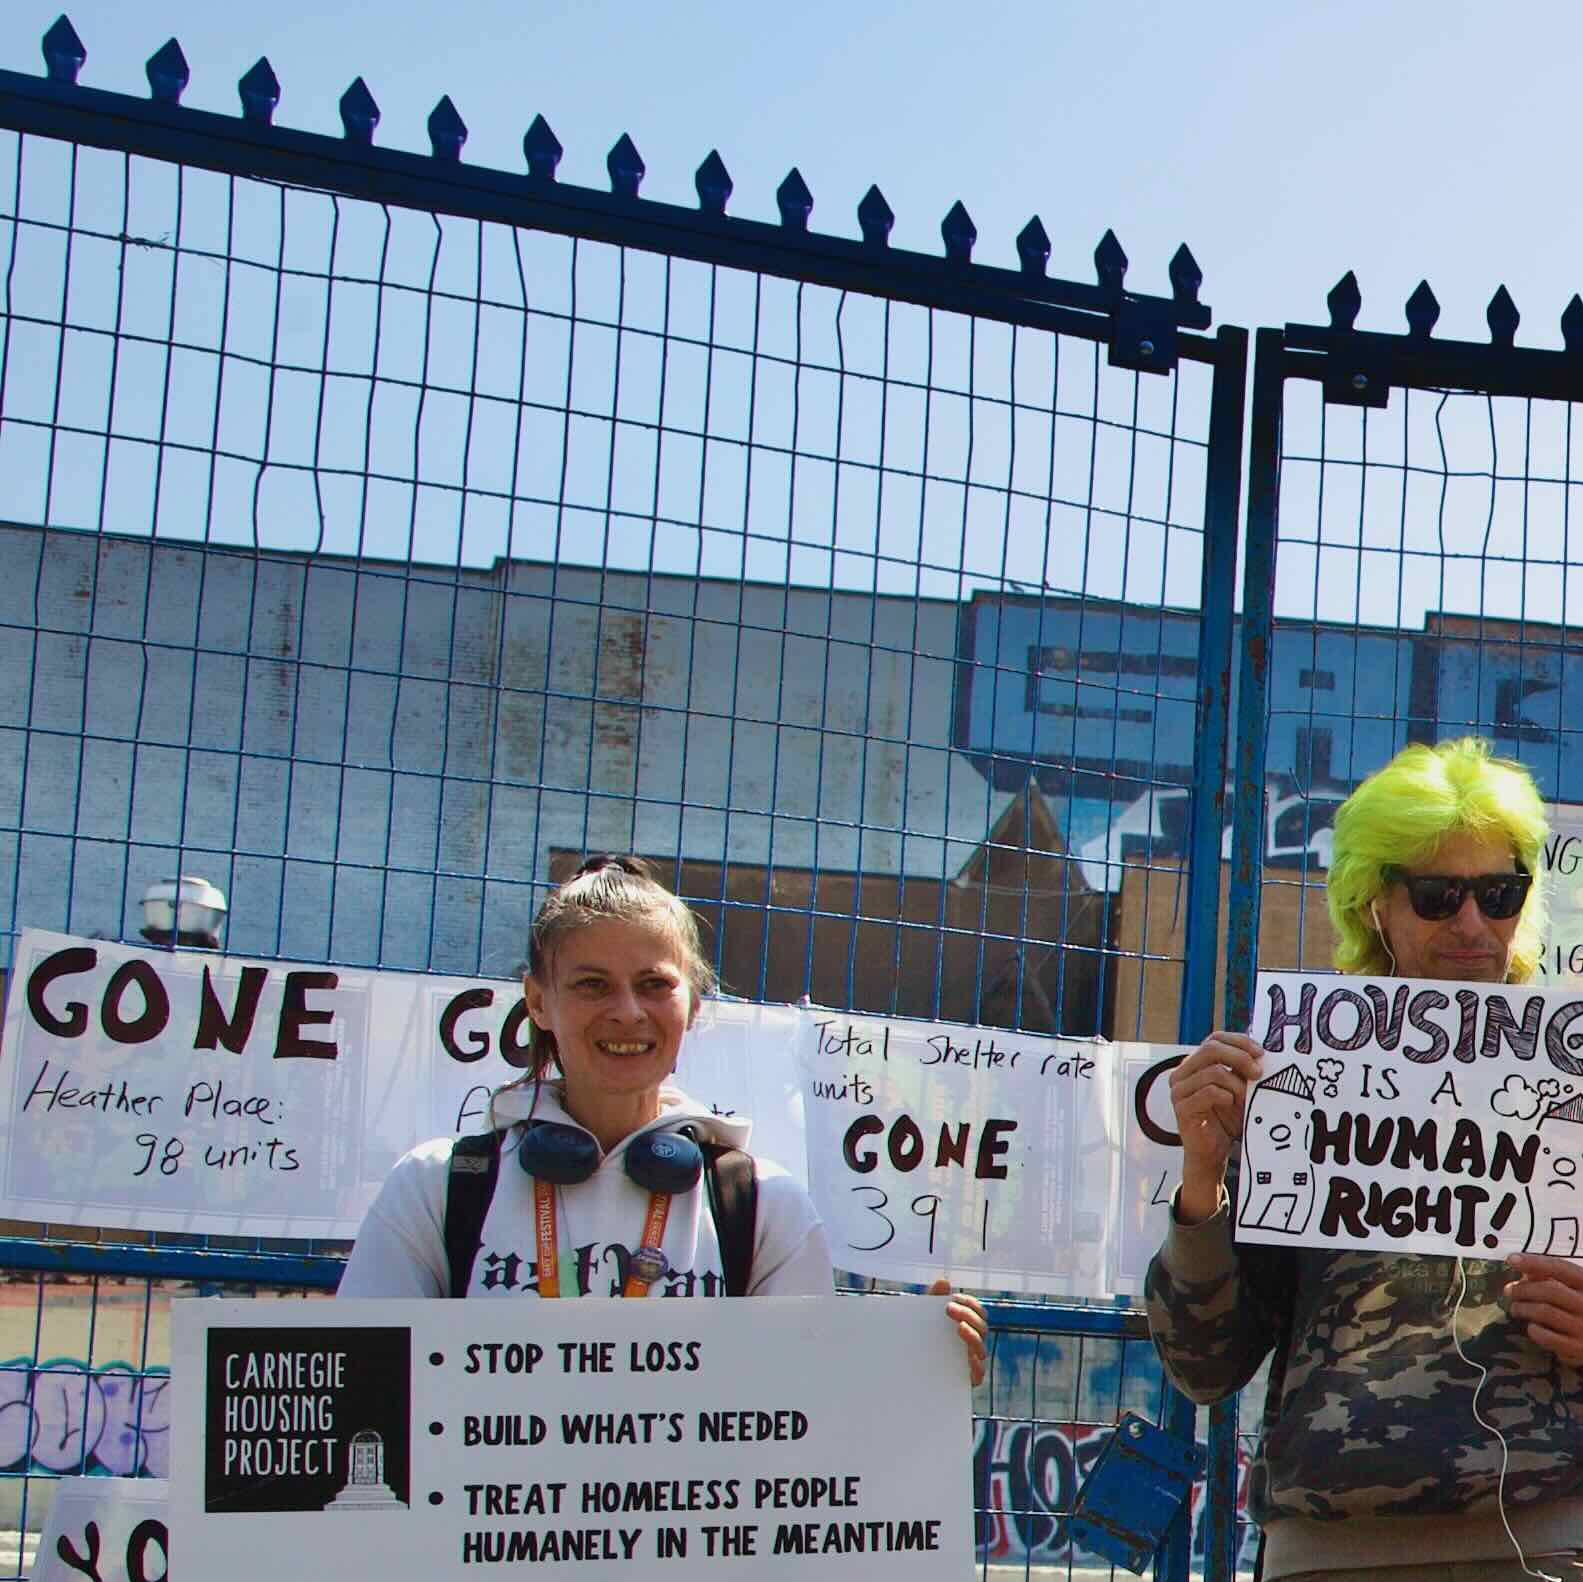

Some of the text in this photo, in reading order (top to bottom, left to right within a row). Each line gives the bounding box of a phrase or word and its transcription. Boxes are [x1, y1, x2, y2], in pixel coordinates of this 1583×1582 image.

[26, 946, 340, 1061] GONE
[814, 1022, 890, 1060] Total
[1040, 1046, 1096, 1081] rate
[22, 1060, 164, 1113] Heather
[812, 1073, 875, 1106] units
[1361, 1065, 1462, 1107] IS A
[133, 1133, 301, 1177] 98 units
[842, 1113, 1018, 1181] GONE
[1310, 1108, 1542, 1185] HUMAN
[1320, 1177, 1517, 1249] RIGHT!
[224, 1351, 348, 1389] CARNEGIE
[463, 1340, 702, 1375] STOP THE LOSS
[224, 1395, 334, 1433] HOUSING
[463, 1410, 809, 1447] BUILD WHAT'S NEEDED
[224, 1438, 339, 1477] PROJECT
[463, 1476, 861, 1516] TREAT HOMELESS PEOPLE
[463, 1520, 942, 1564] HUMANELY IN THE MEANTIME
